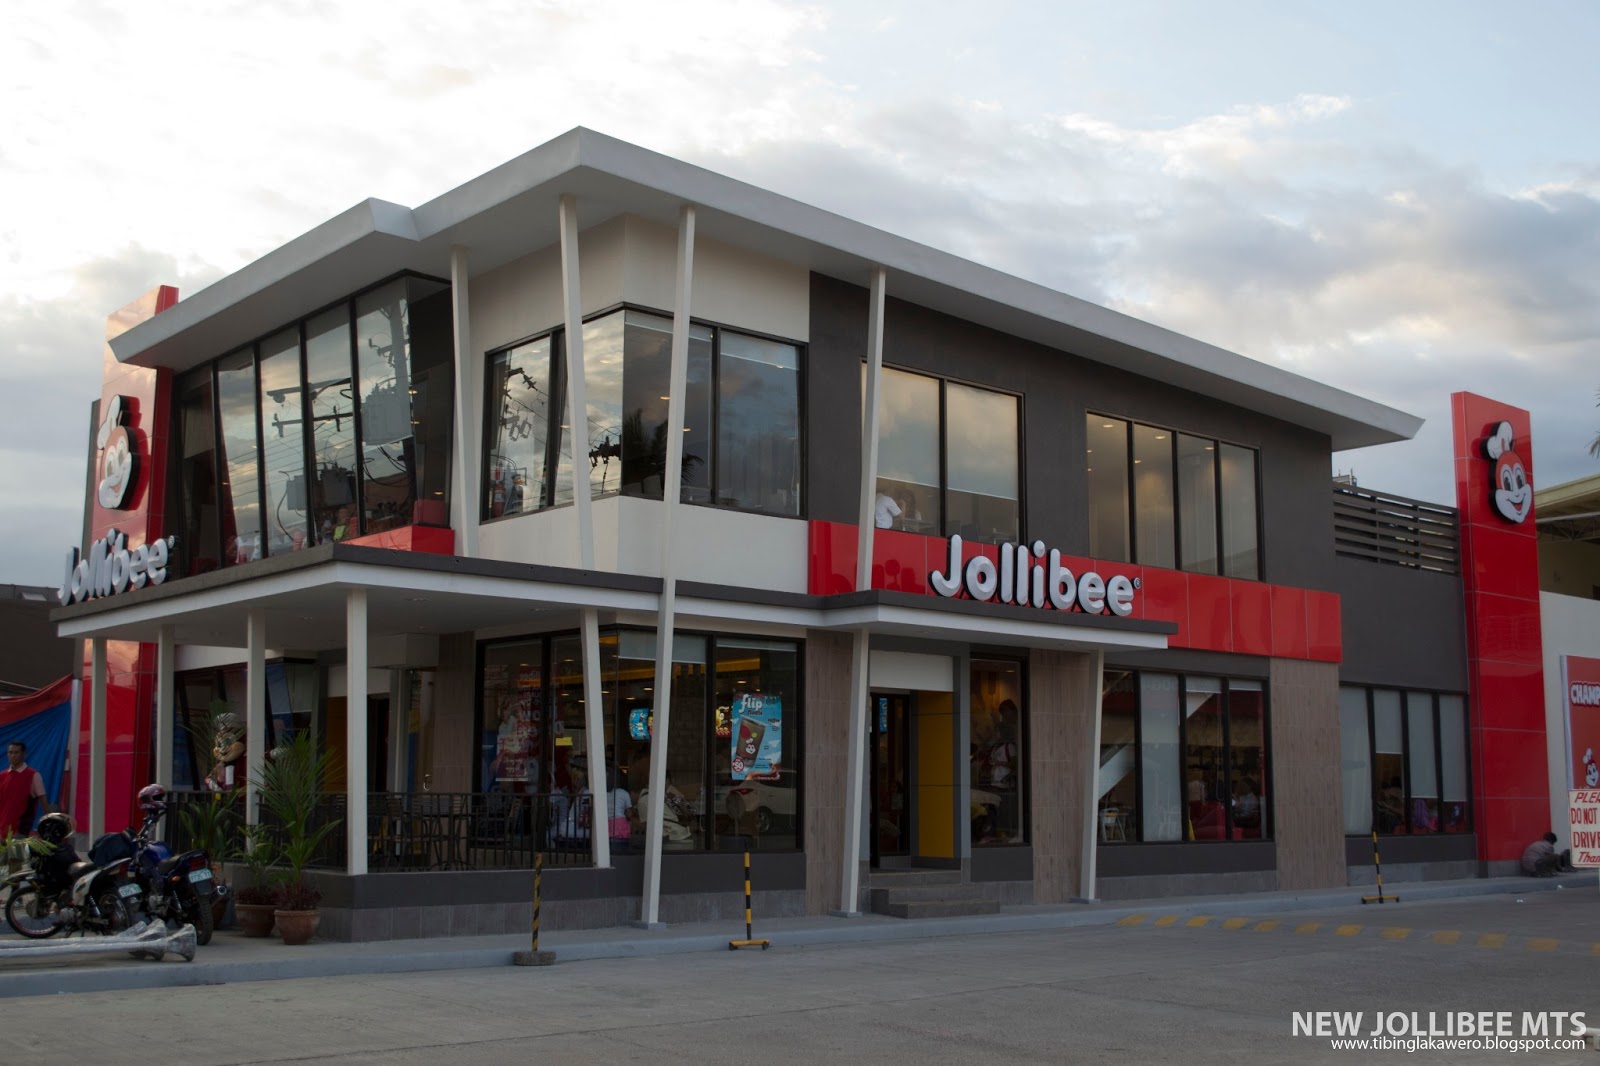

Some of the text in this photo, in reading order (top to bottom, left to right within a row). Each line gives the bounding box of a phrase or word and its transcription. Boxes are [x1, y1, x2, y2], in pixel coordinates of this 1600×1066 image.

[57, 527, 168, 606] Jollibee
[929, 533, 1134, 617] Jollibee
[738, 693, 763, 714] flip
[1570, 807, 1598, 825] DO NOT
